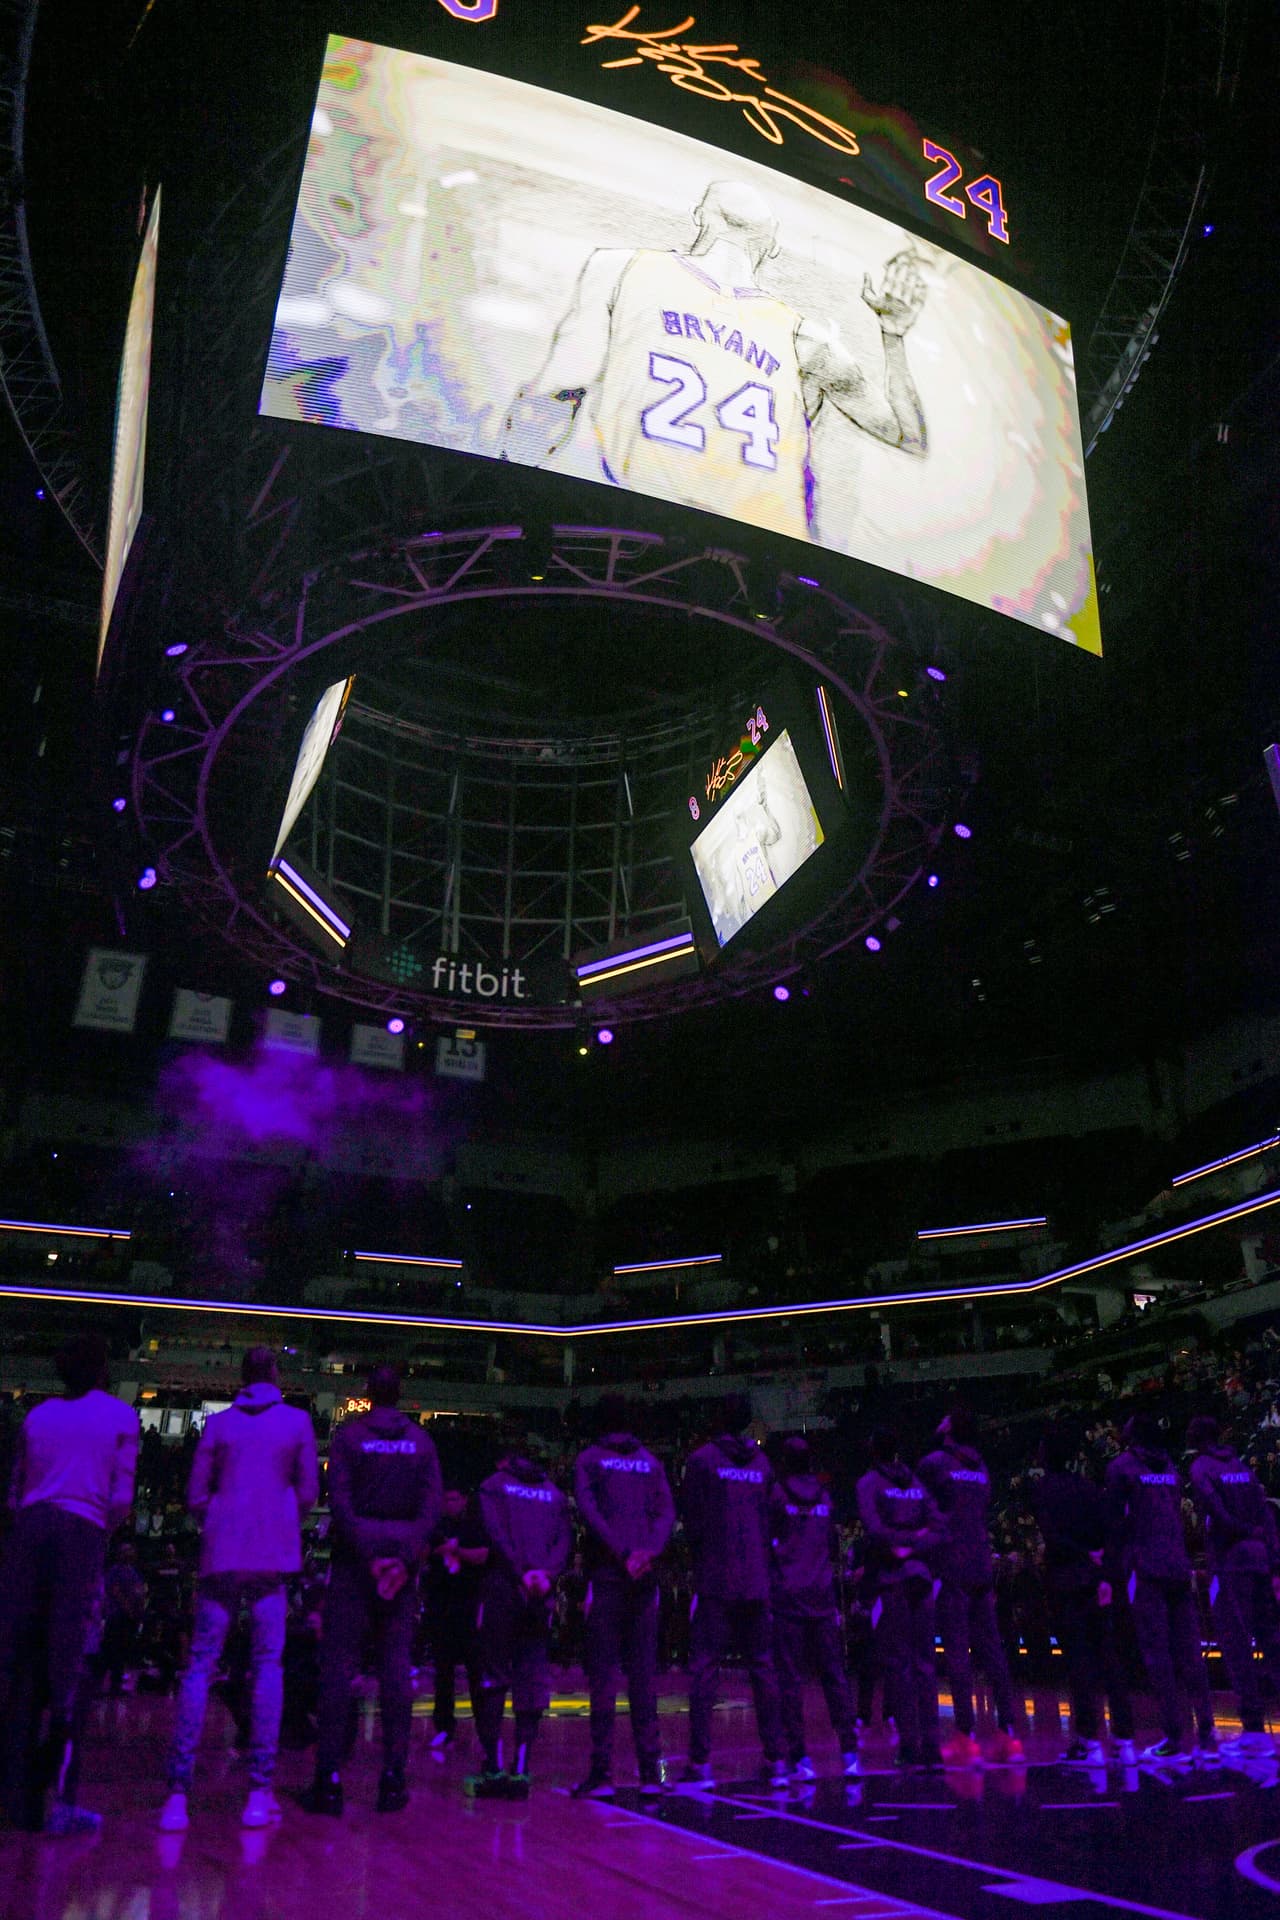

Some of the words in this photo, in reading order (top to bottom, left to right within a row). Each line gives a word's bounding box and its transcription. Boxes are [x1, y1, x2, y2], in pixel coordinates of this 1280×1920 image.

[923, 138, 1009, 244] 24
[660, 309, 781, 378] BRYANT
[640, 350, 780, 472] 24
[746, 706, 769, 746] 24
[688, 795, 700, 821] 8
[431, 957, 526, 999] fitbit
[362, 1440, 417, 1455] WOLVES
[601, 1458, 651, 1474] WOLVES
[717, 1467, 764, 1484] WOLVES
[504, 1483, 552, 1502] WOLVES
